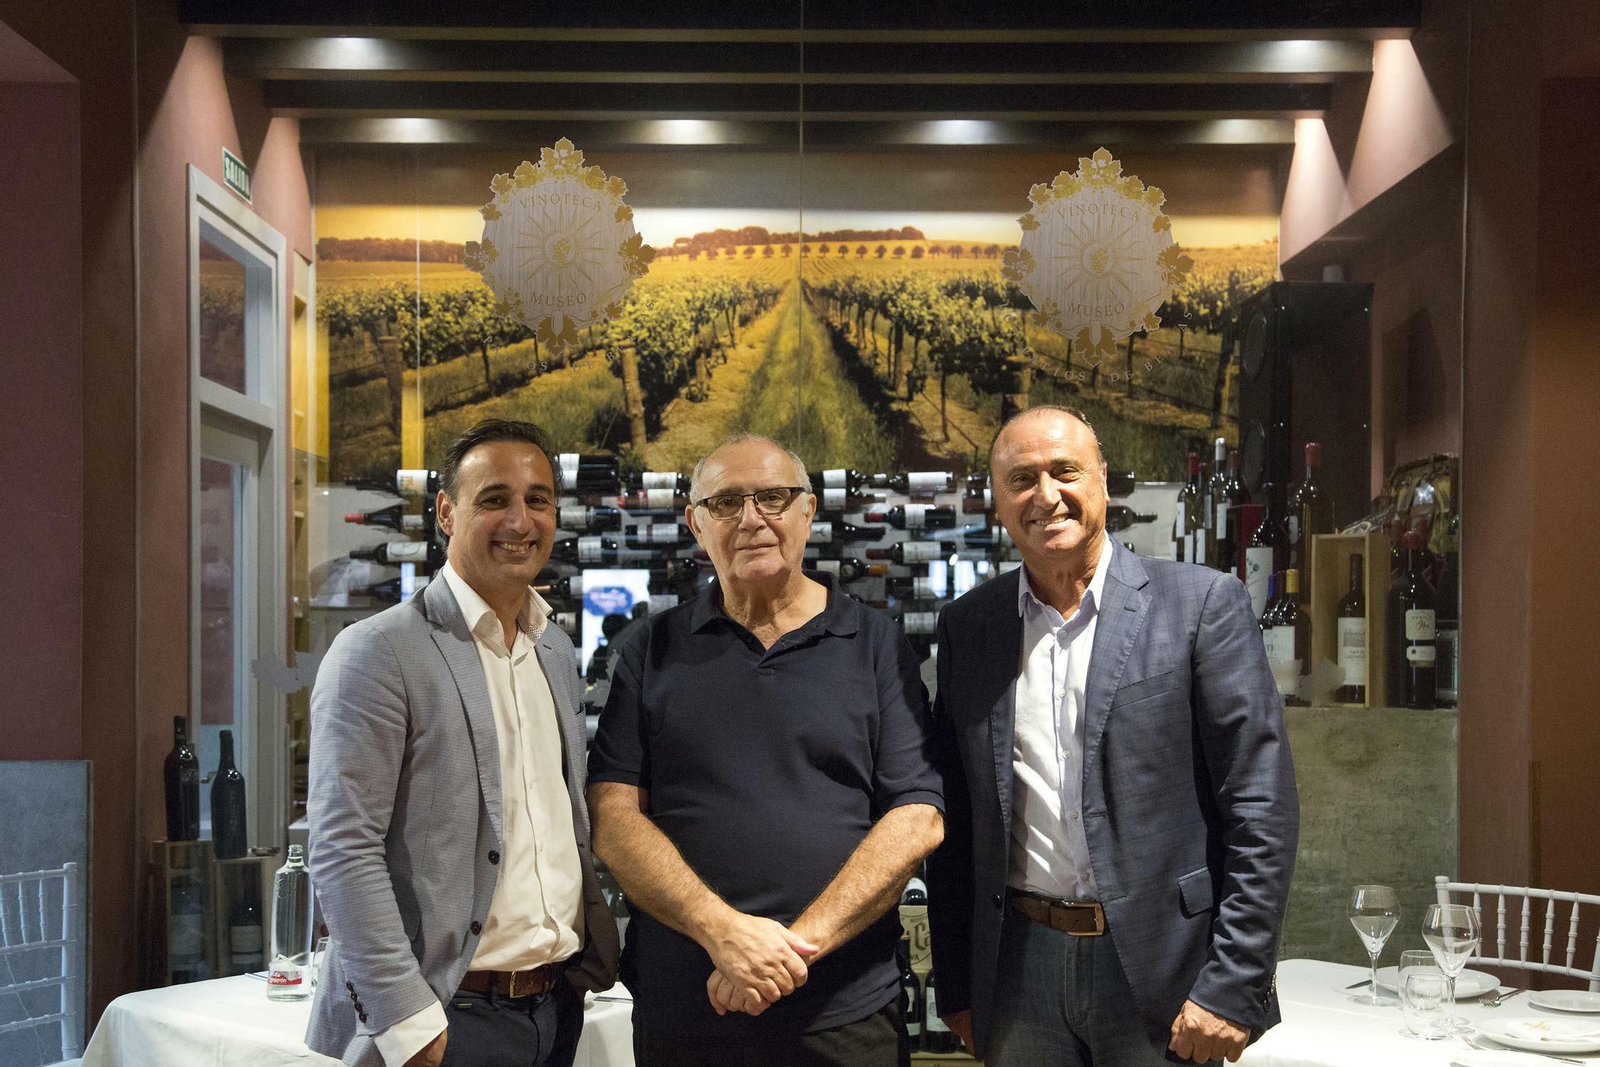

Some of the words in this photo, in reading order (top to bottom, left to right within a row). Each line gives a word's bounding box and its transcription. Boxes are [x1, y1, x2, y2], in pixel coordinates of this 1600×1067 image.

[519, 193, 602, 212] VINOTECA
[1057, 203, 1141, 222] VINOTECA
[530, 291, 588, 307] MUSEO
[1067, 302, 1126, 317] MUSEO
[1110, 370, 1134, 383] DE
[1144, 311, 1193, 373] BEAAS
